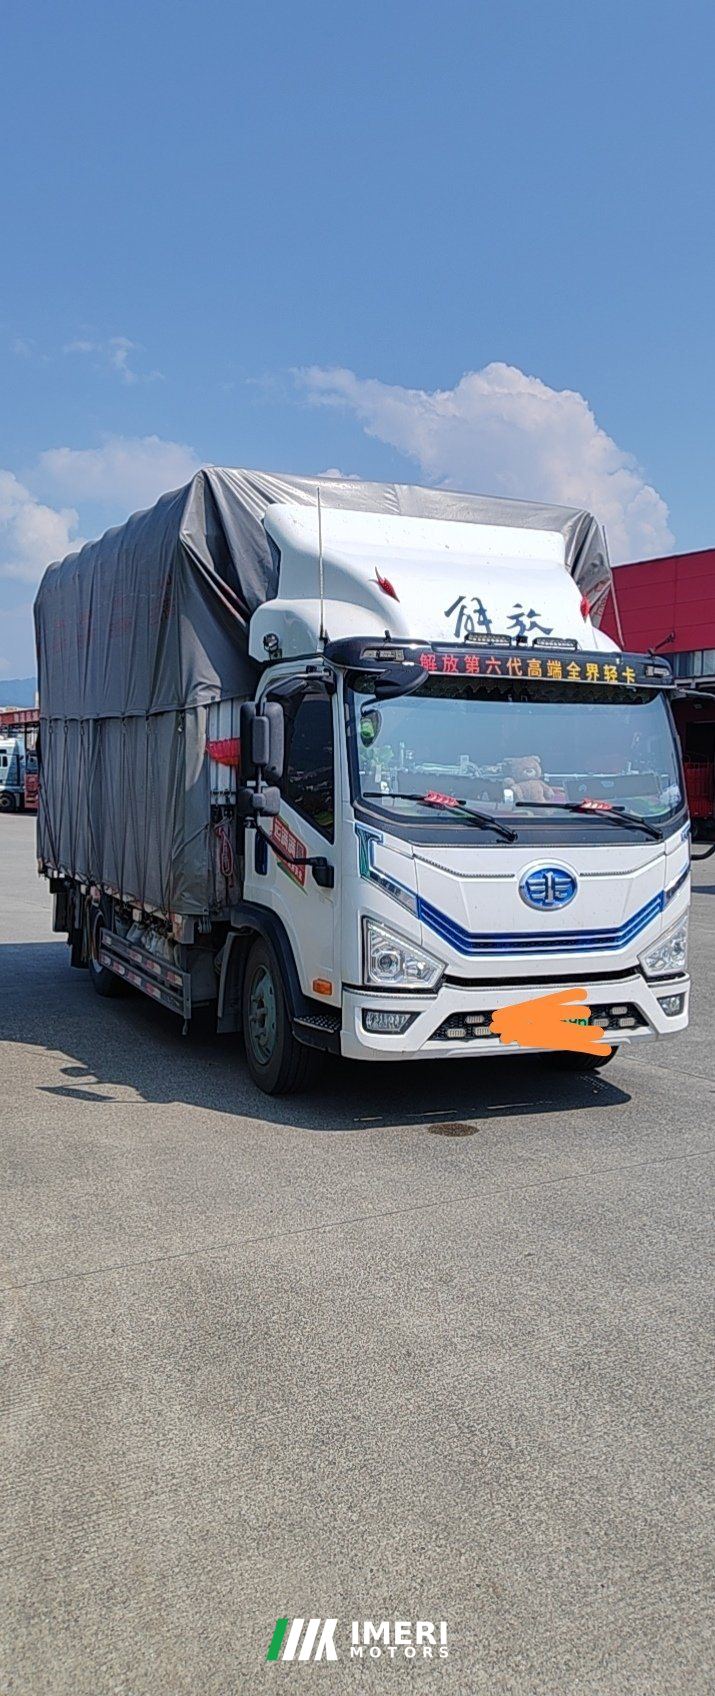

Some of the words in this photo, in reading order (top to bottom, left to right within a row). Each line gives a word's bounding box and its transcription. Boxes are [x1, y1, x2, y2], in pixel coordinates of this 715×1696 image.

[444, 596, 554, 640] 解放
[419, 652, 637, 684] 解放第六代高端全界轻卡
